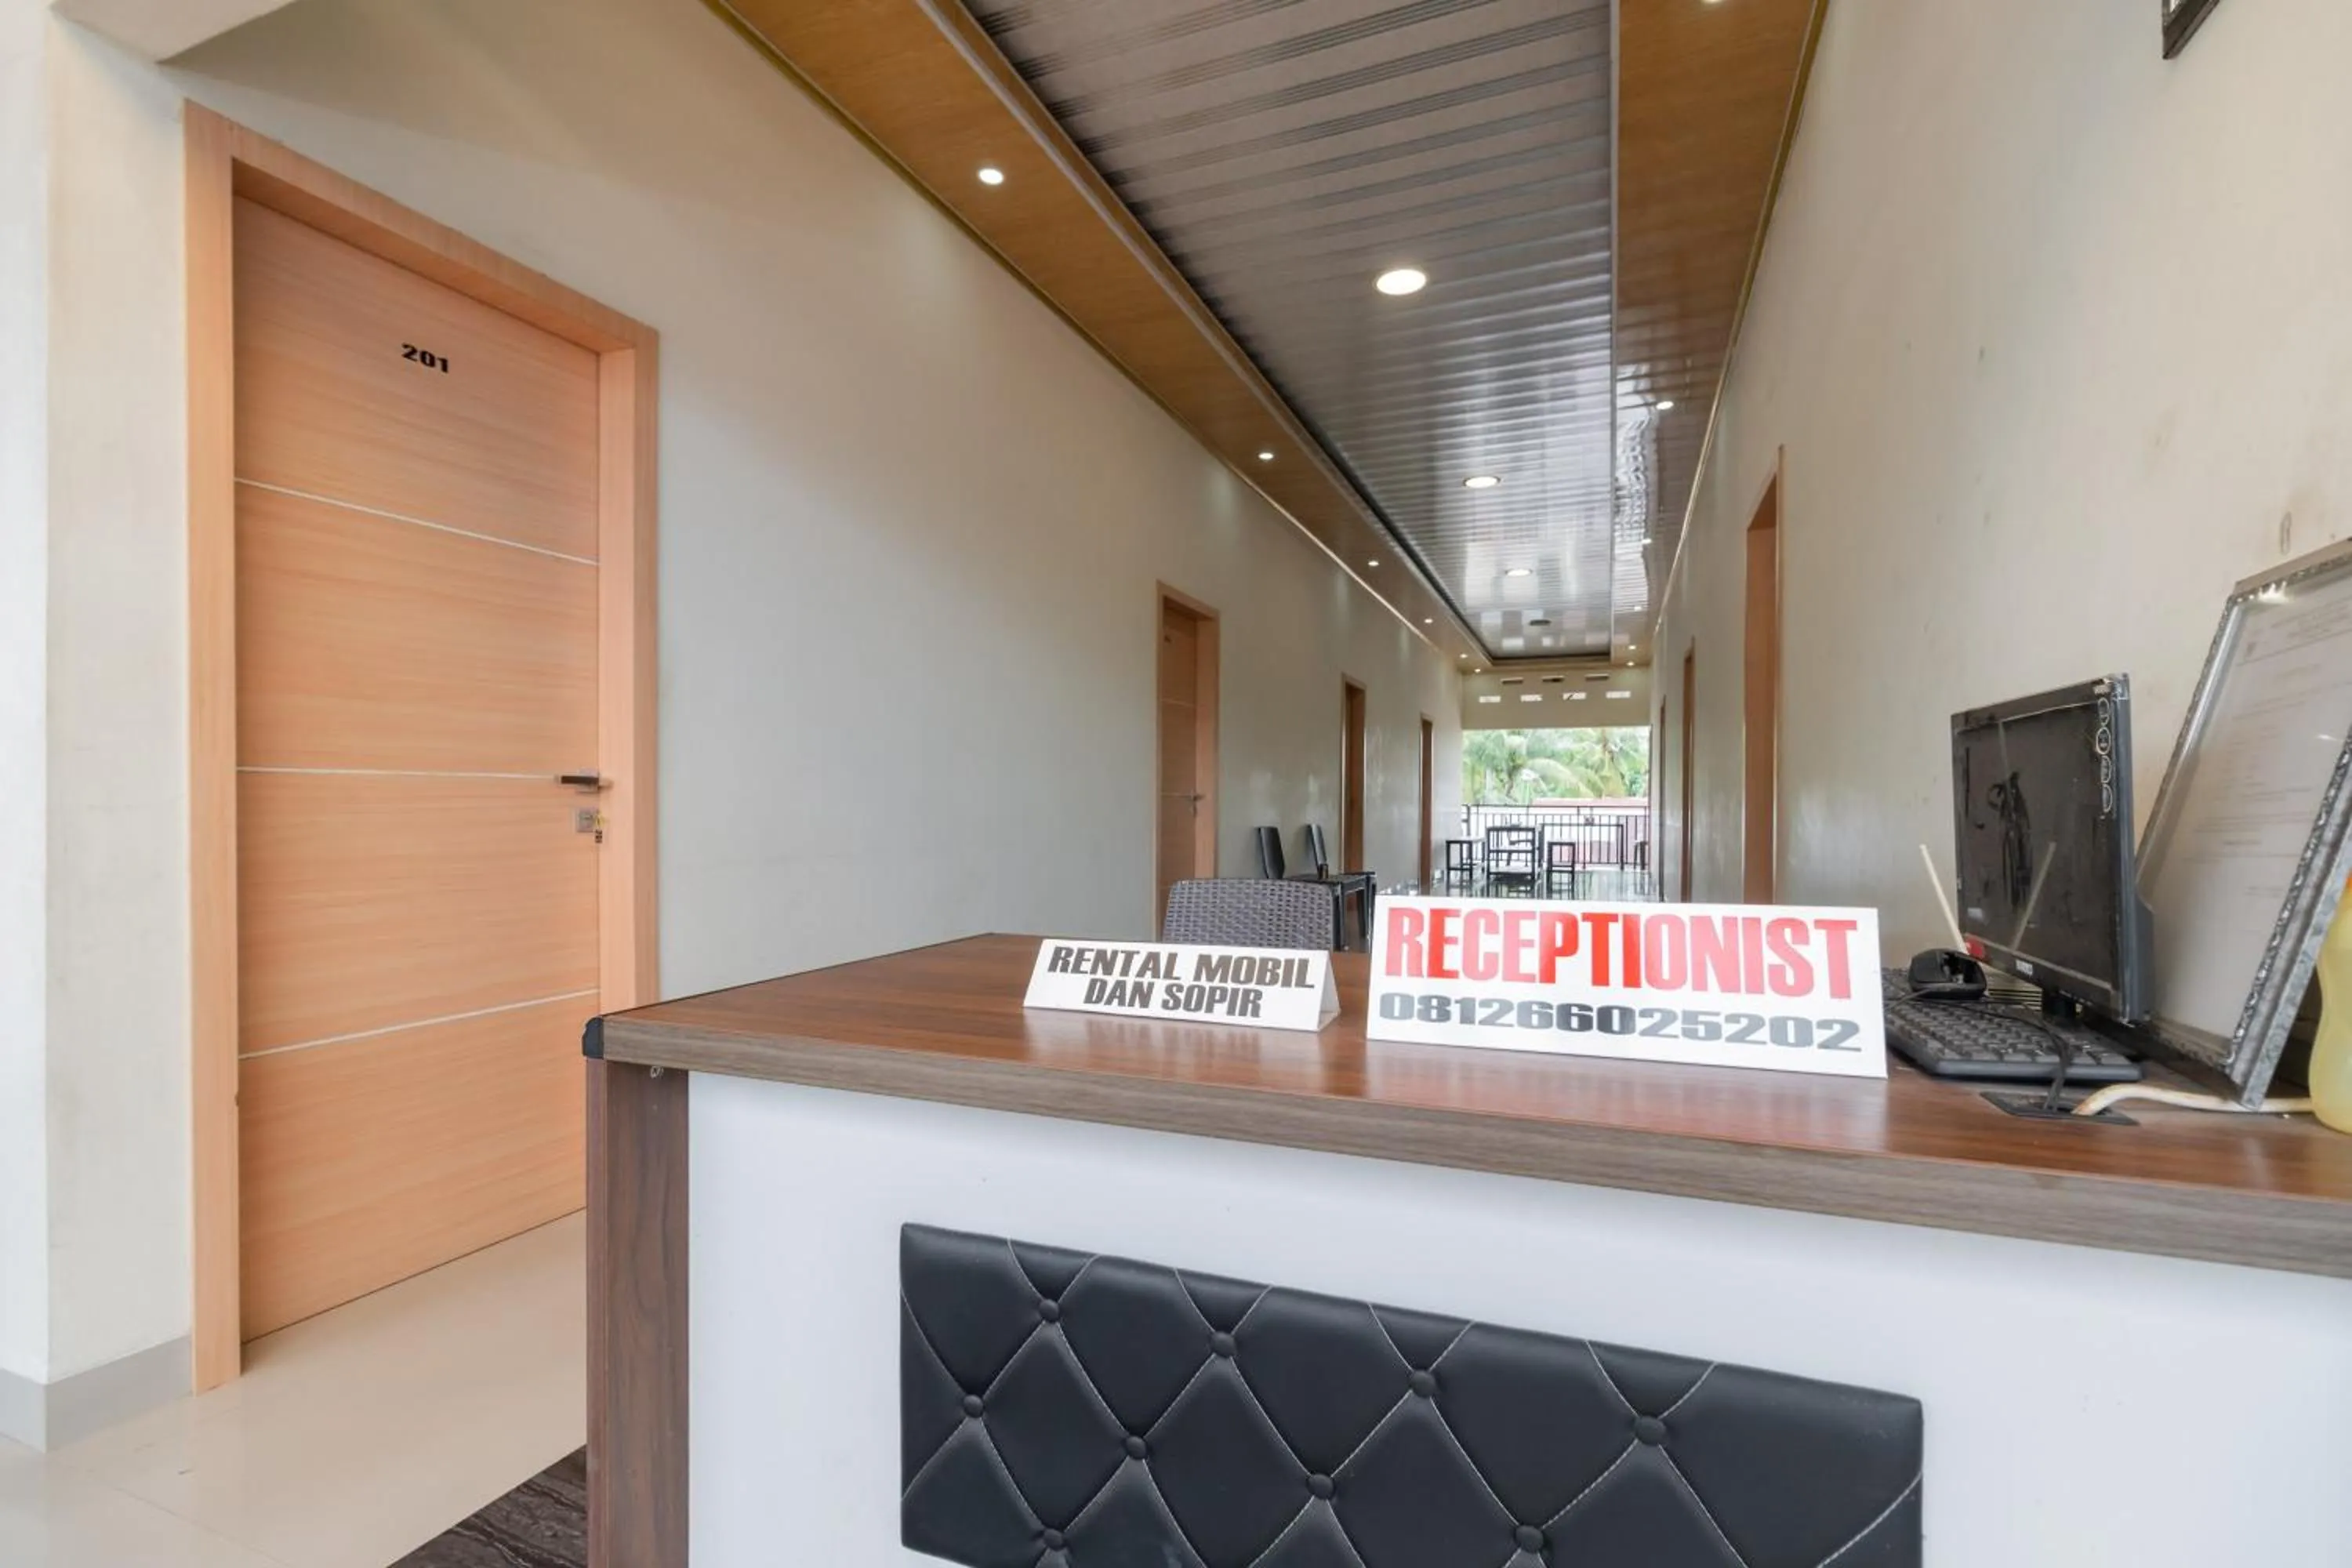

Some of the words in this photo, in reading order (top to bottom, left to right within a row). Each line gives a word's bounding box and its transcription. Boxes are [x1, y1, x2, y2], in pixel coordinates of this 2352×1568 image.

[401, 343, 448, 373] 201
[1047, 946, 1181, 981] RENTAL
[1192, 953, 1315, 989] MOBIL
[1385, 906, 1857, 1000] RECEPTIONIST
[1083, 978, 1155, 1008] DAN
[1161, 982, 1263, 1018] SOPIR
[1379, 992, 1862, 1053] 081266025202
